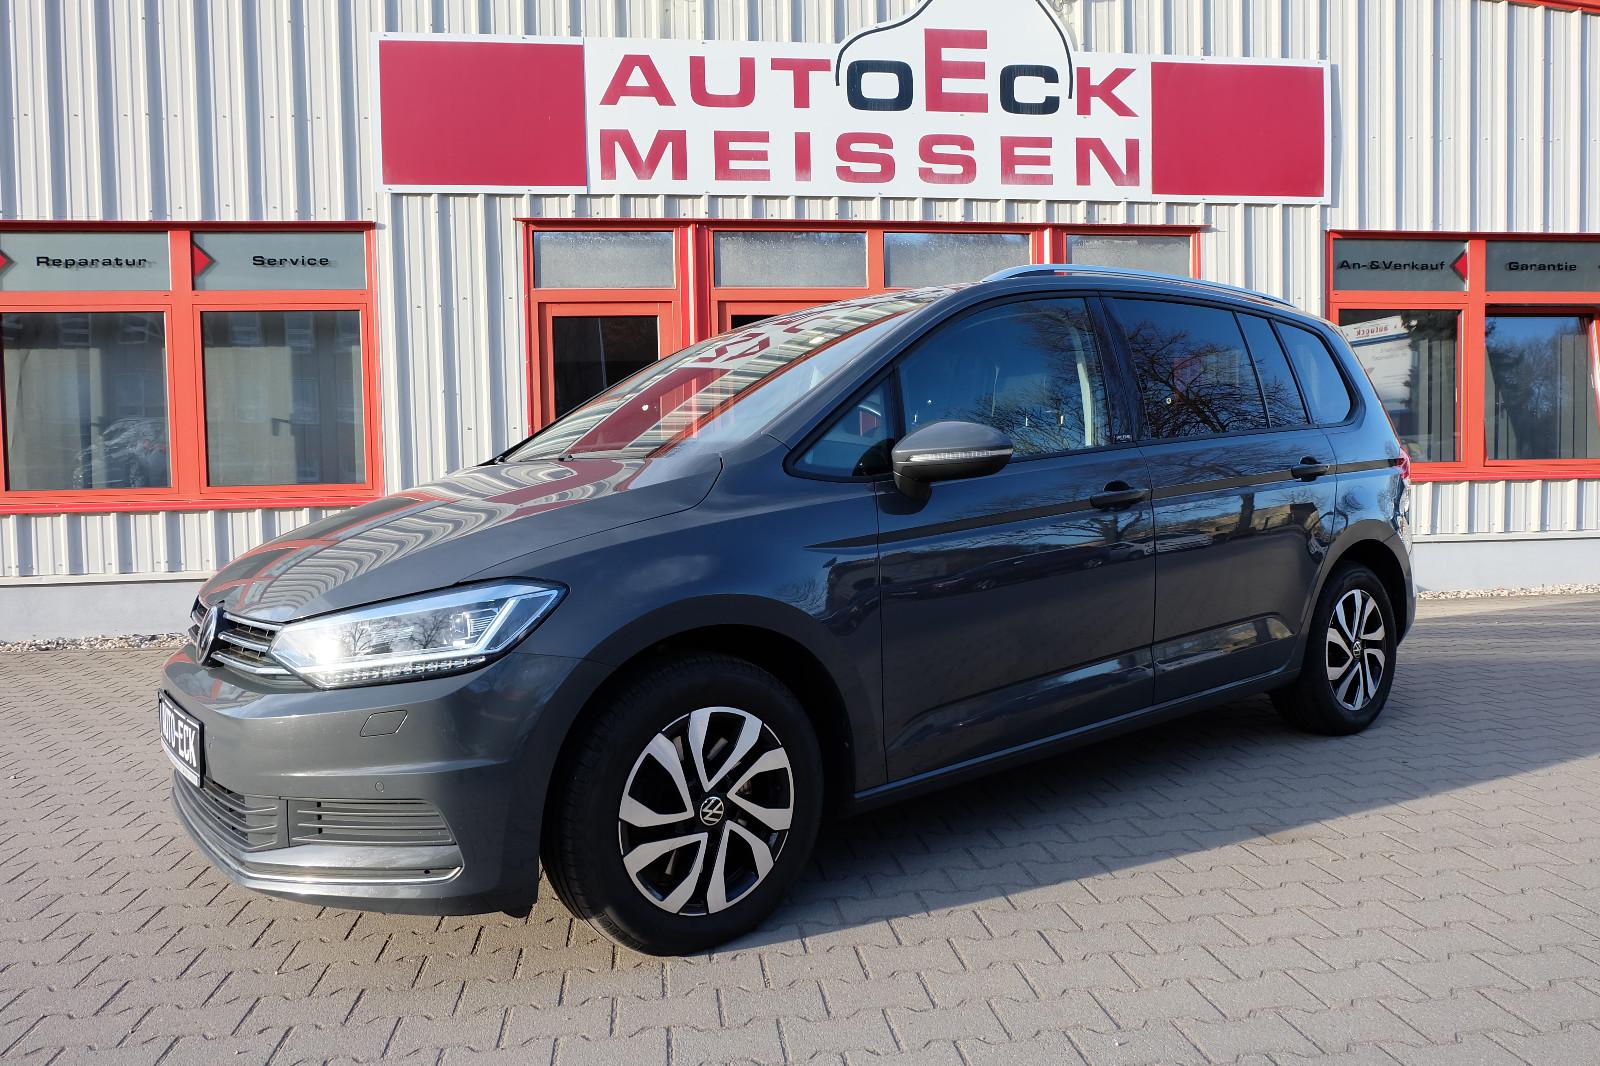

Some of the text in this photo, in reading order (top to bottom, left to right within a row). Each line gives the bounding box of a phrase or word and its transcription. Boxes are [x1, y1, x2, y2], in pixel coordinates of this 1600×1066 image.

[599, 28, 1139, 118] AUTOECK
[599, 128, 1140, 187] MEISSEN
[36, 256, 147, 269] Reparatur
[252, 255, 329, 266] Service
[1508, 261, 1577, 271] Garantie
